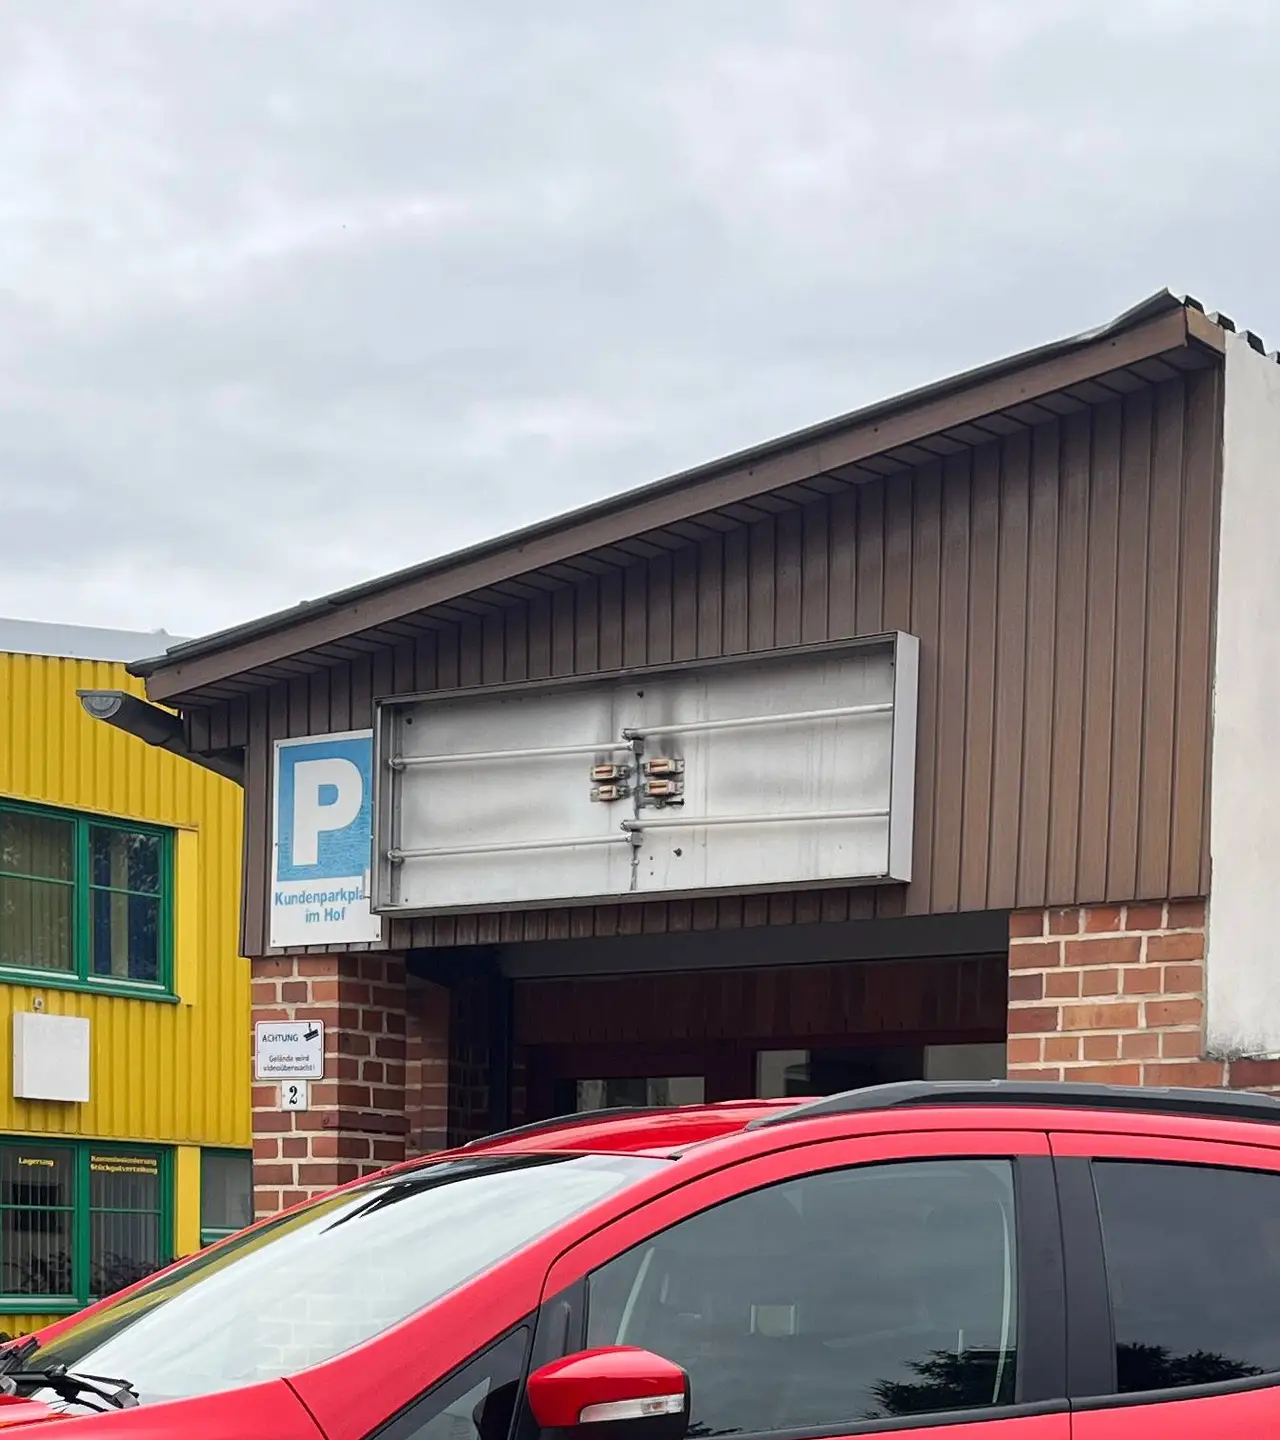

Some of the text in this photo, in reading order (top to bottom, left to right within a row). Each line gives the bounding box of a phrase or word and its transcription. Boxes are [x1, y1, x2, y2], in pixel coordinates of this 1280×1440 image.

[291, 757, 363, 866] P
[275, 885, 365, 907] Kundenparkpla
[305, 906, 346, 923] im Hof
[262, 1034, 299, 1043] ACHTUNG
[295, 1054, 310, 1062] wird
[288, 1085, 298, 1105] 2
